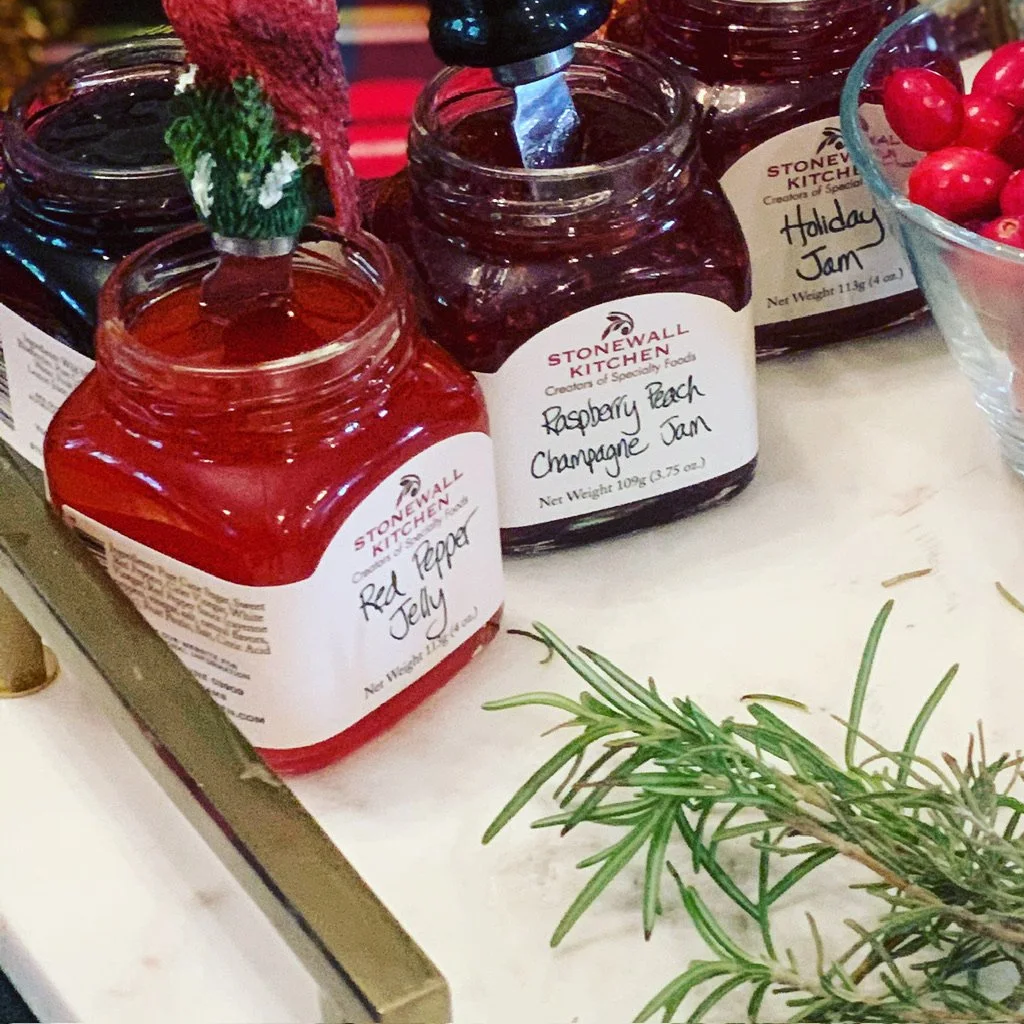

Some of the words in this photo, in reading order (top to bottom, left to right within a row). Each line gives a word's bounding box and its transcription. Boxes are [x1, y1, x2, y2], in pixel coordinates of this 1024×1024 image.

[763, 192, 808, 206] Creators
[811, 185, 822, 197] of
[825, 178, 864, 195] Special
[787, 164, 860, 191] KITCHE
[780, 198, 885, 251] Holiday
[796, 245, 864, 281] Jam
[767, 295, 789, 308] Net
[793, 286, 835, 302] Weight
[838, 279, 867, 293] 113g
[868, 276, 880, 289] (4
[547, 324, 690, 367] STONEWALL
[569, 343, 670, 378] KITCHEN
[544, 378, 593, 396] Creators
[596, 373, 609, 386] of
[611, 363, 661, 383] Specialty
[664, 351, 697, 368] Foods
[542, 394, 641, 437] Raspberry
[645, 374, 706, 411] Peach
[531, 437, 650, 479] Champagne
[660, 415, 712, 446] Jam
[539, 495, 563, 509] Net
[566, 483, 613, 501] Weight
[617, 475, 647, 492] 109g
[649, 464, 680, 484] (3.75
[354, 469, 464, 551] STONEWALL
[372, 493, 450, 557] KITCHEN
[359, 570, 407, 621] Red
[412, 506, 480, 581] Pepper
[389, 586, 448, 640] Jelly
[364, 680, 384, 699] Net
[386, 651, 424, 683] Weight
